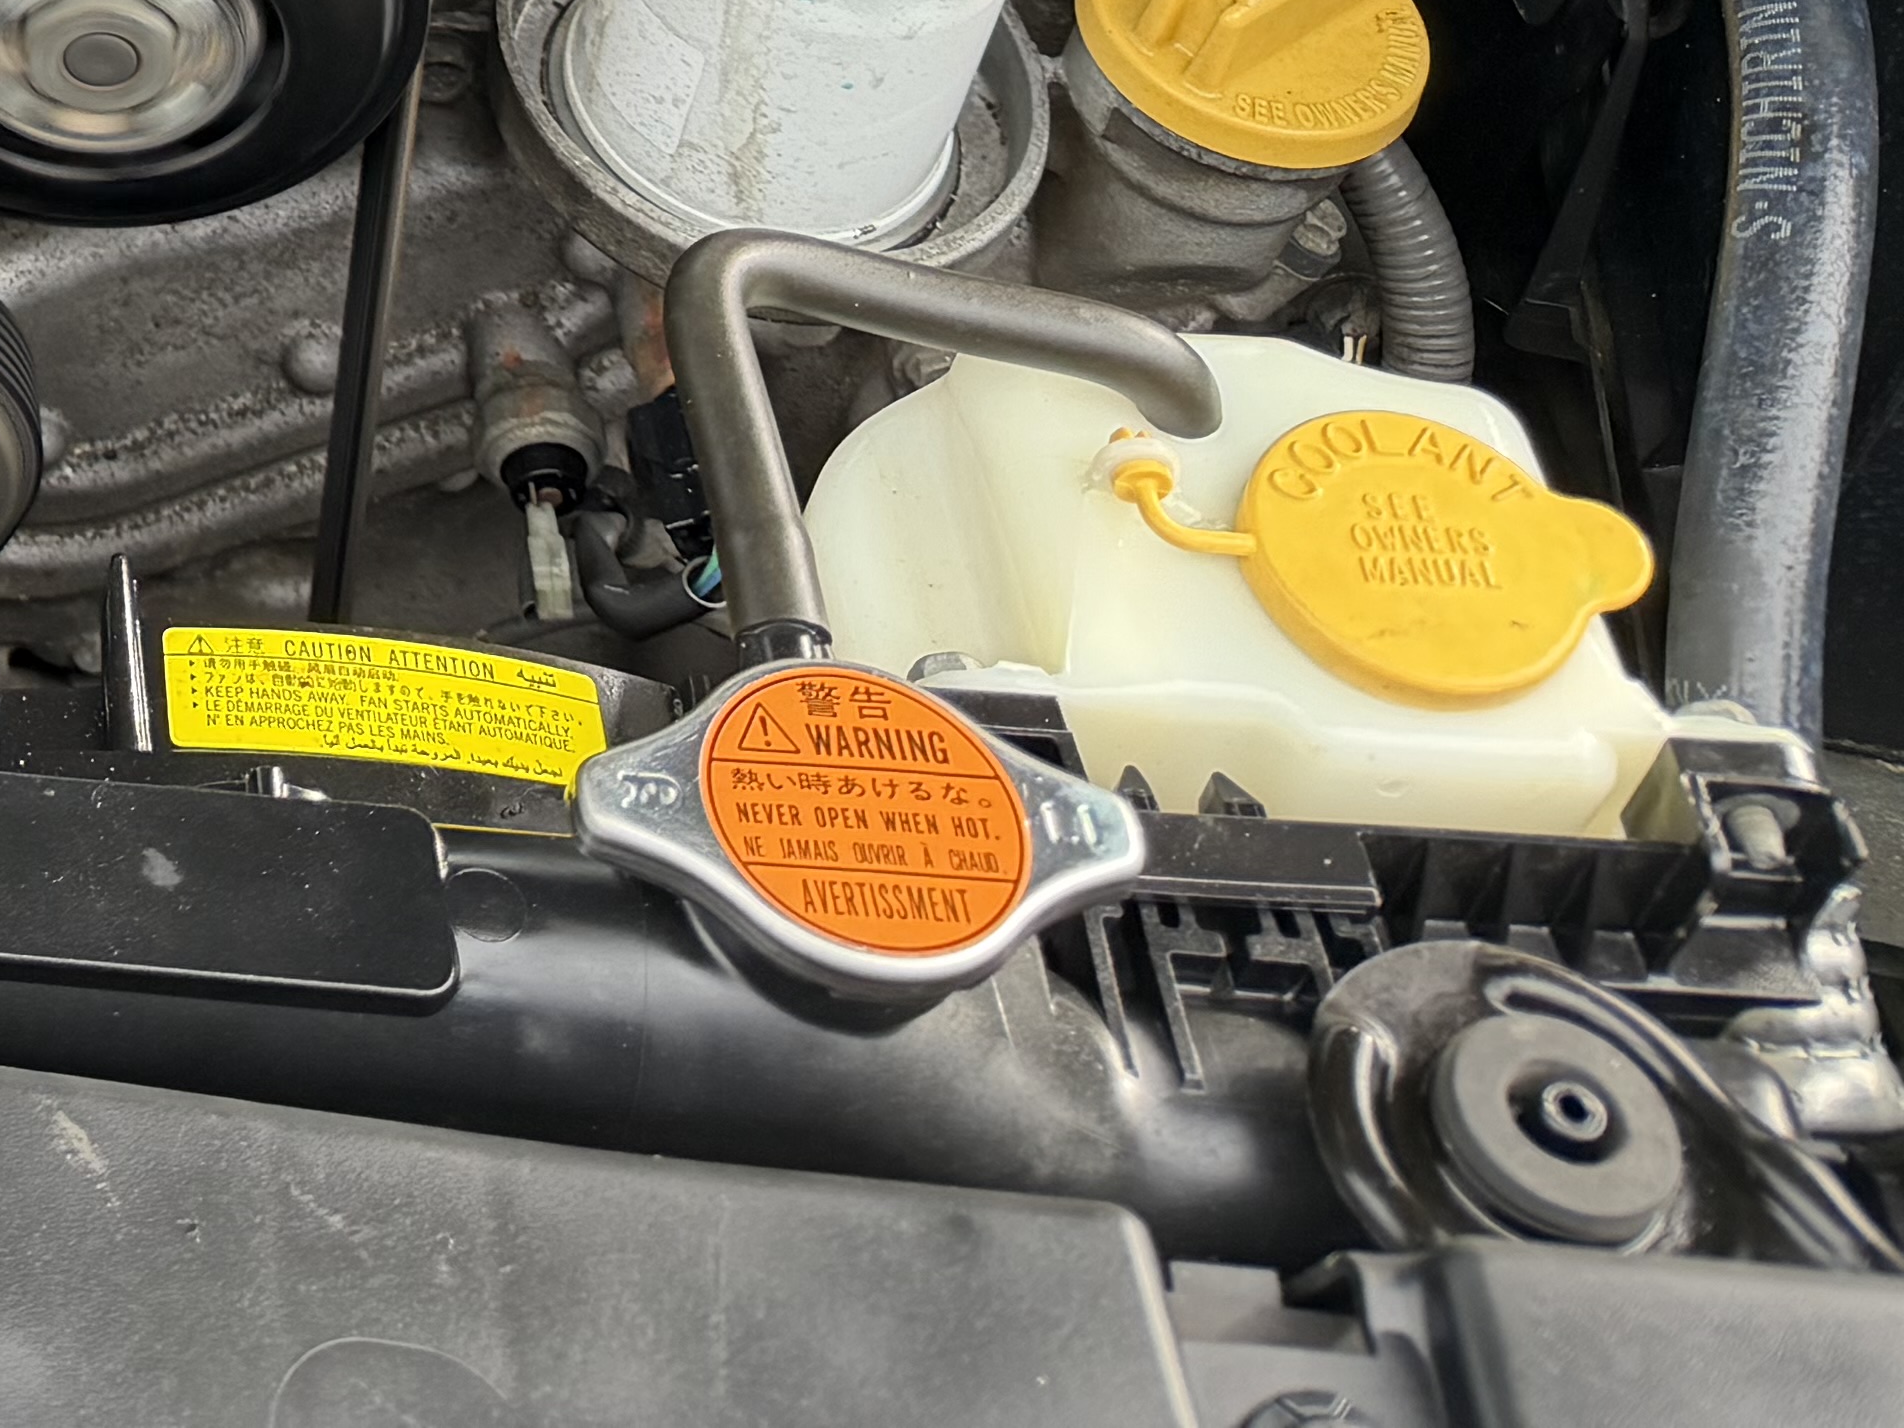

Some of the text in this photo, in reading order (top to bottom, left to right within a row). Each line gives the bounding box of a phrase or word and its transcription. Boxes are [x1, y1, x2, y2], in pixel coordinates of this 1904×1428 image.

[1233, 92, 1290, 127] SEE
[1266, 418, 1534, 502] COOLANT
[1361, 492, 1429, 522] SEE
[1349, 522, 1494, 556] OWNERS
[1357, 555, 1503, 591] MANUAL
[224, 636, 266, 655] 注意
[284, 639, 495, 680] CAUTION ATTENTION
[204, 685, 244, 699] KEEP
[249, 687, 302, 702] HANDS
[360, 695, 388, 710] FAN
[393, 699, 450, 719] STARTS
[205, 700, 222, 713] LE
[315, 706, 334, 719] DU
[338, 708, 428, 730] VENTILATEUR
[794, 680, 892, 722] 警告
[226, 715, 245, 727] EN
[249, 716, 334, 733] APPROCHEZ
[338, 722, 365, 736] PAS
[369, 724, 396, 740] LES
[400, 728, 450, 746] MAINS.
[804, 722, 951, 766] WARNING
[735, 801, 1002, 841] NEVER OPEN WHEN HOT.
[743, 835, 766, 858] NE
[779, 836, 839, 863] JAMAIS
[853, 841, 909, 867] OUVRIR
[948, 847, 1009, 876] CHAUD.
[801, 878, 973, 925] AVERTISSMENT
